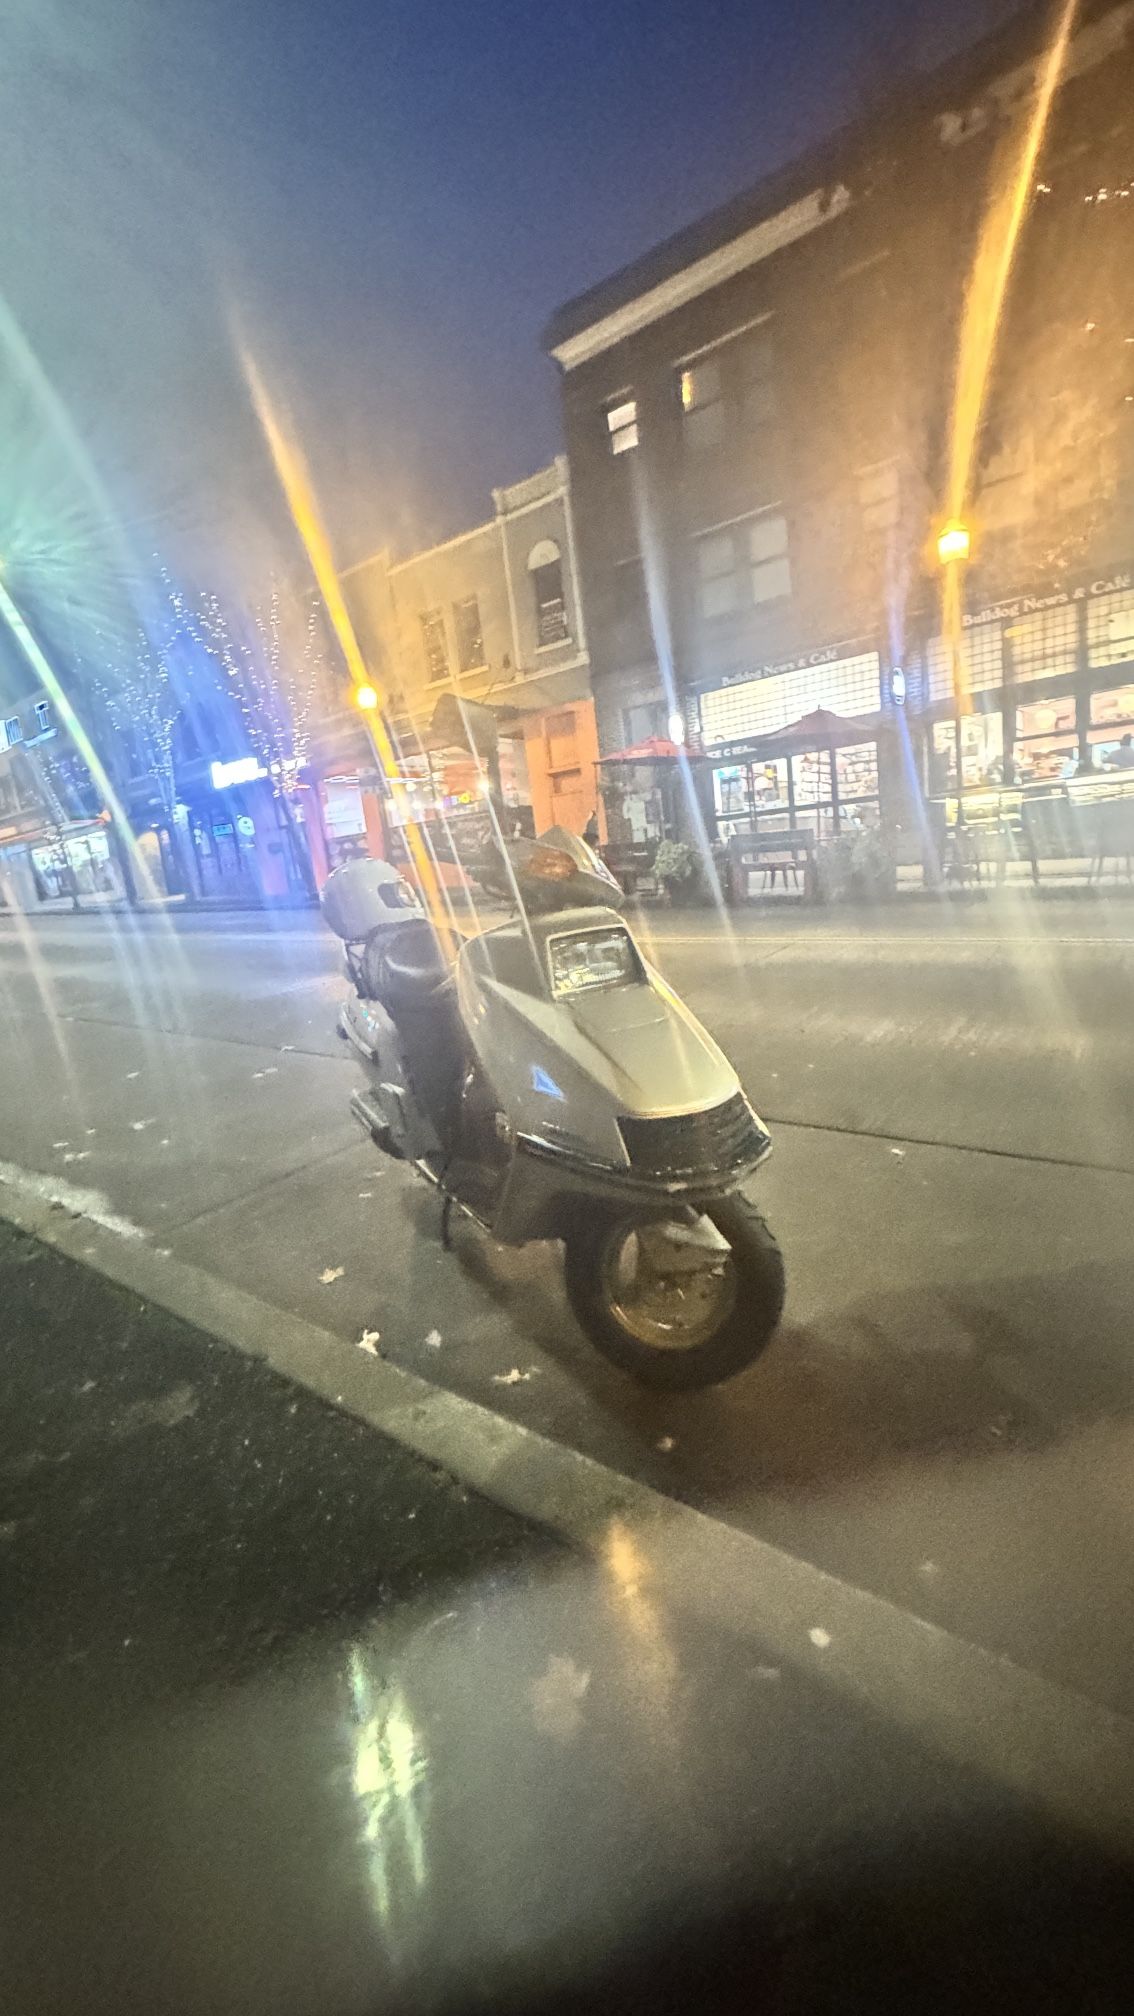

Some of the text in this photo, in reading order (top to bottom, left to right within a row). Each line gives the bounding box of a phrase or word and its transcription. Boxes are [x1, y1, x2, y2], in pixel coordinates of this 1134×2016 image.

[962, 603, 1020, 627] Bulldog
[1023, 593, 1069, 612] News
[1073, 587, 1086, 599] &
